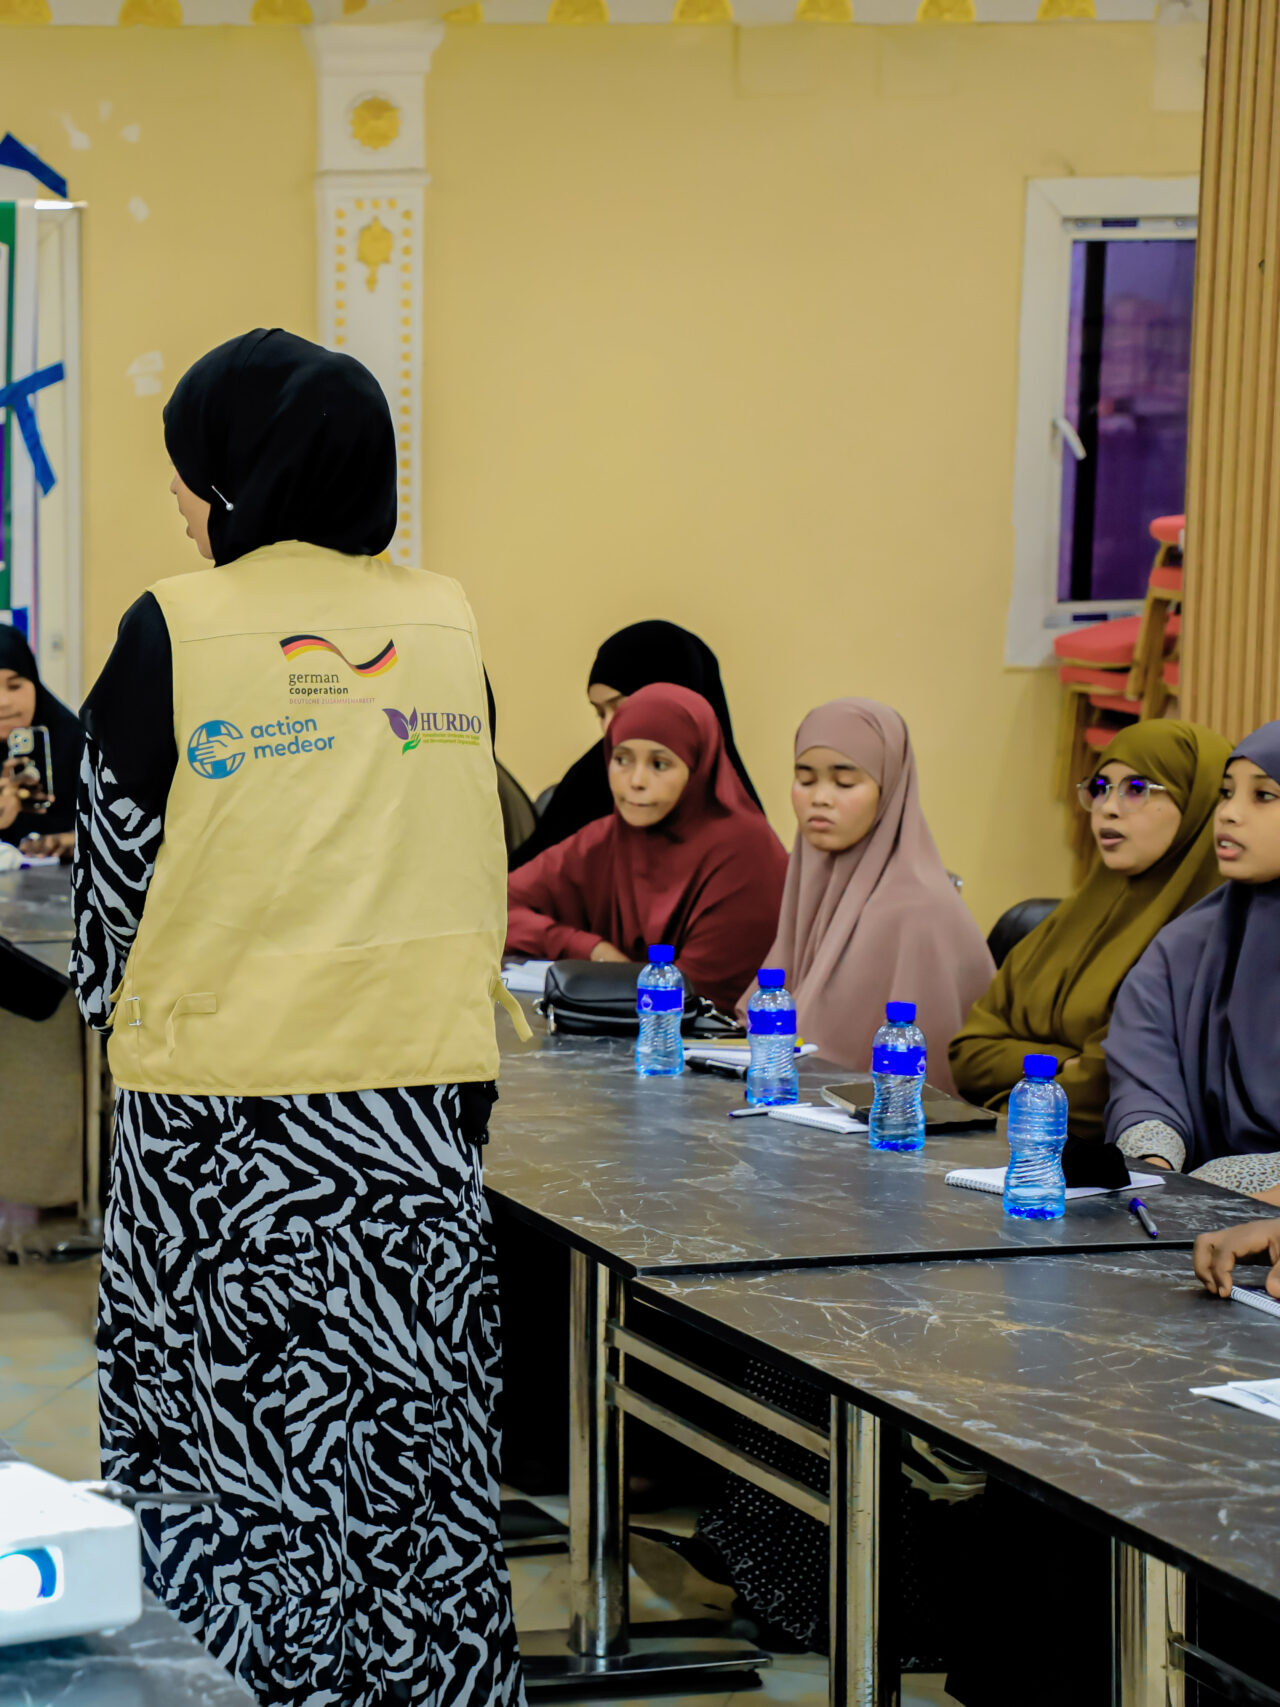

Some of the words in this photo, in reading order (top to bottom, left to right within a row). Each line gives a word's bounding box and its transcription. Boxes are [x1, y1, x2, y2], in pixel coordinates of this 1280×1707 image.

[289, 673, 339, 687] german
[289, 685, 349, 697] cooperation
[250, 715, 318, 739] action
[420, 712, 482, 734] HURDO
[253, 735, 335, 760] medeor
